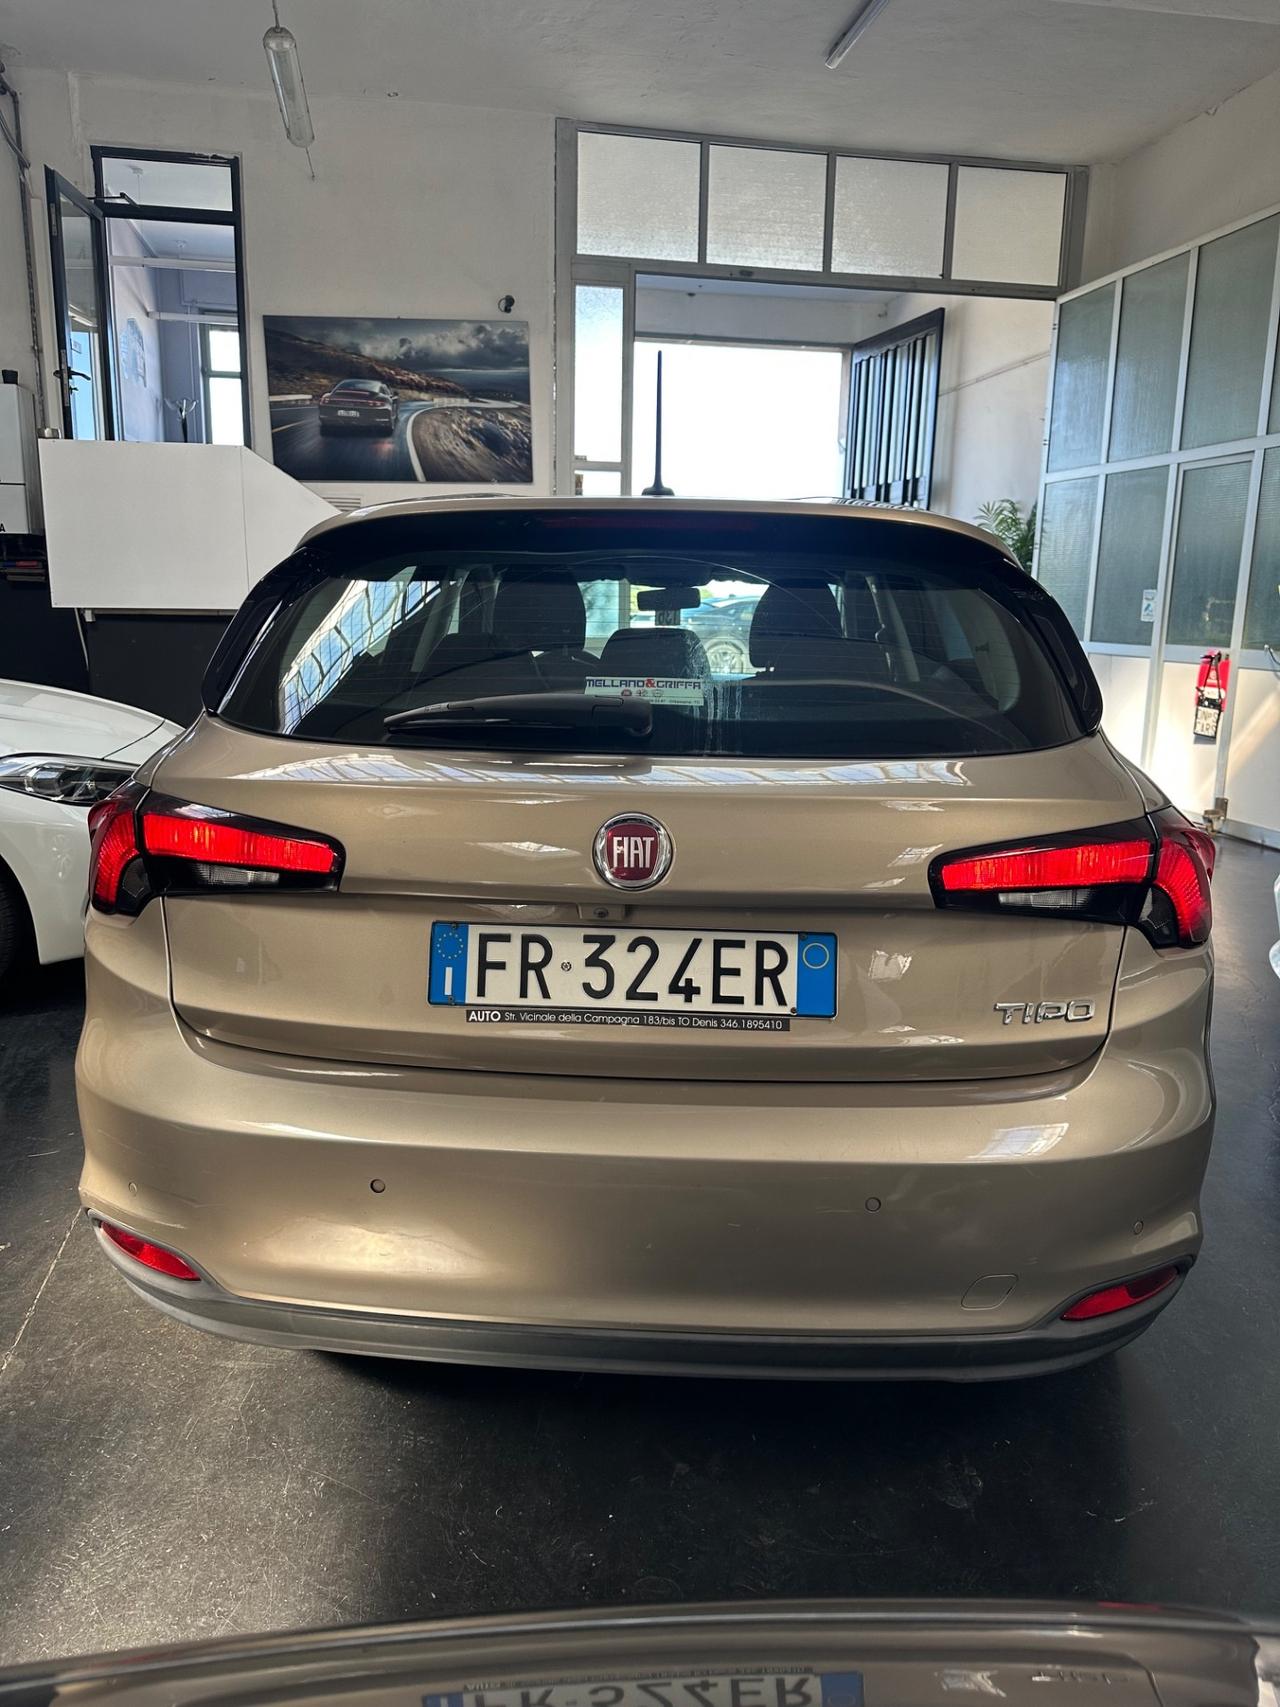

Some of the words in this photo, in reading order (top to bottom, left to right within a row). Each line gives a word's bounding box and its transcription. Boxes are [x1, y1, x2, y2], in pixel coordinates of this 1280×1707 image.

[613, 836, 655, 868] FIAT
[476, 933, 553, 999] FR
[582, 934, 788, 1007] 324ER
[468, 1010, 501, 1022] AUTO
[504, 1011, 517, 1022] Str.
[520, 1011, 556, 1022] Vicinale
[558, 1012, 582, 1023] della
[584, 1013, 640, 1026] Campagna
[643, 1015, 676, 1026] 183/bis
[678, 1016, 690, 1026] TO
[692, 1016, 718, 1027] Denis
[720, 1018, 783, 1030] 346.1895410
[994, 1001, 1096, 1024] TIPO
